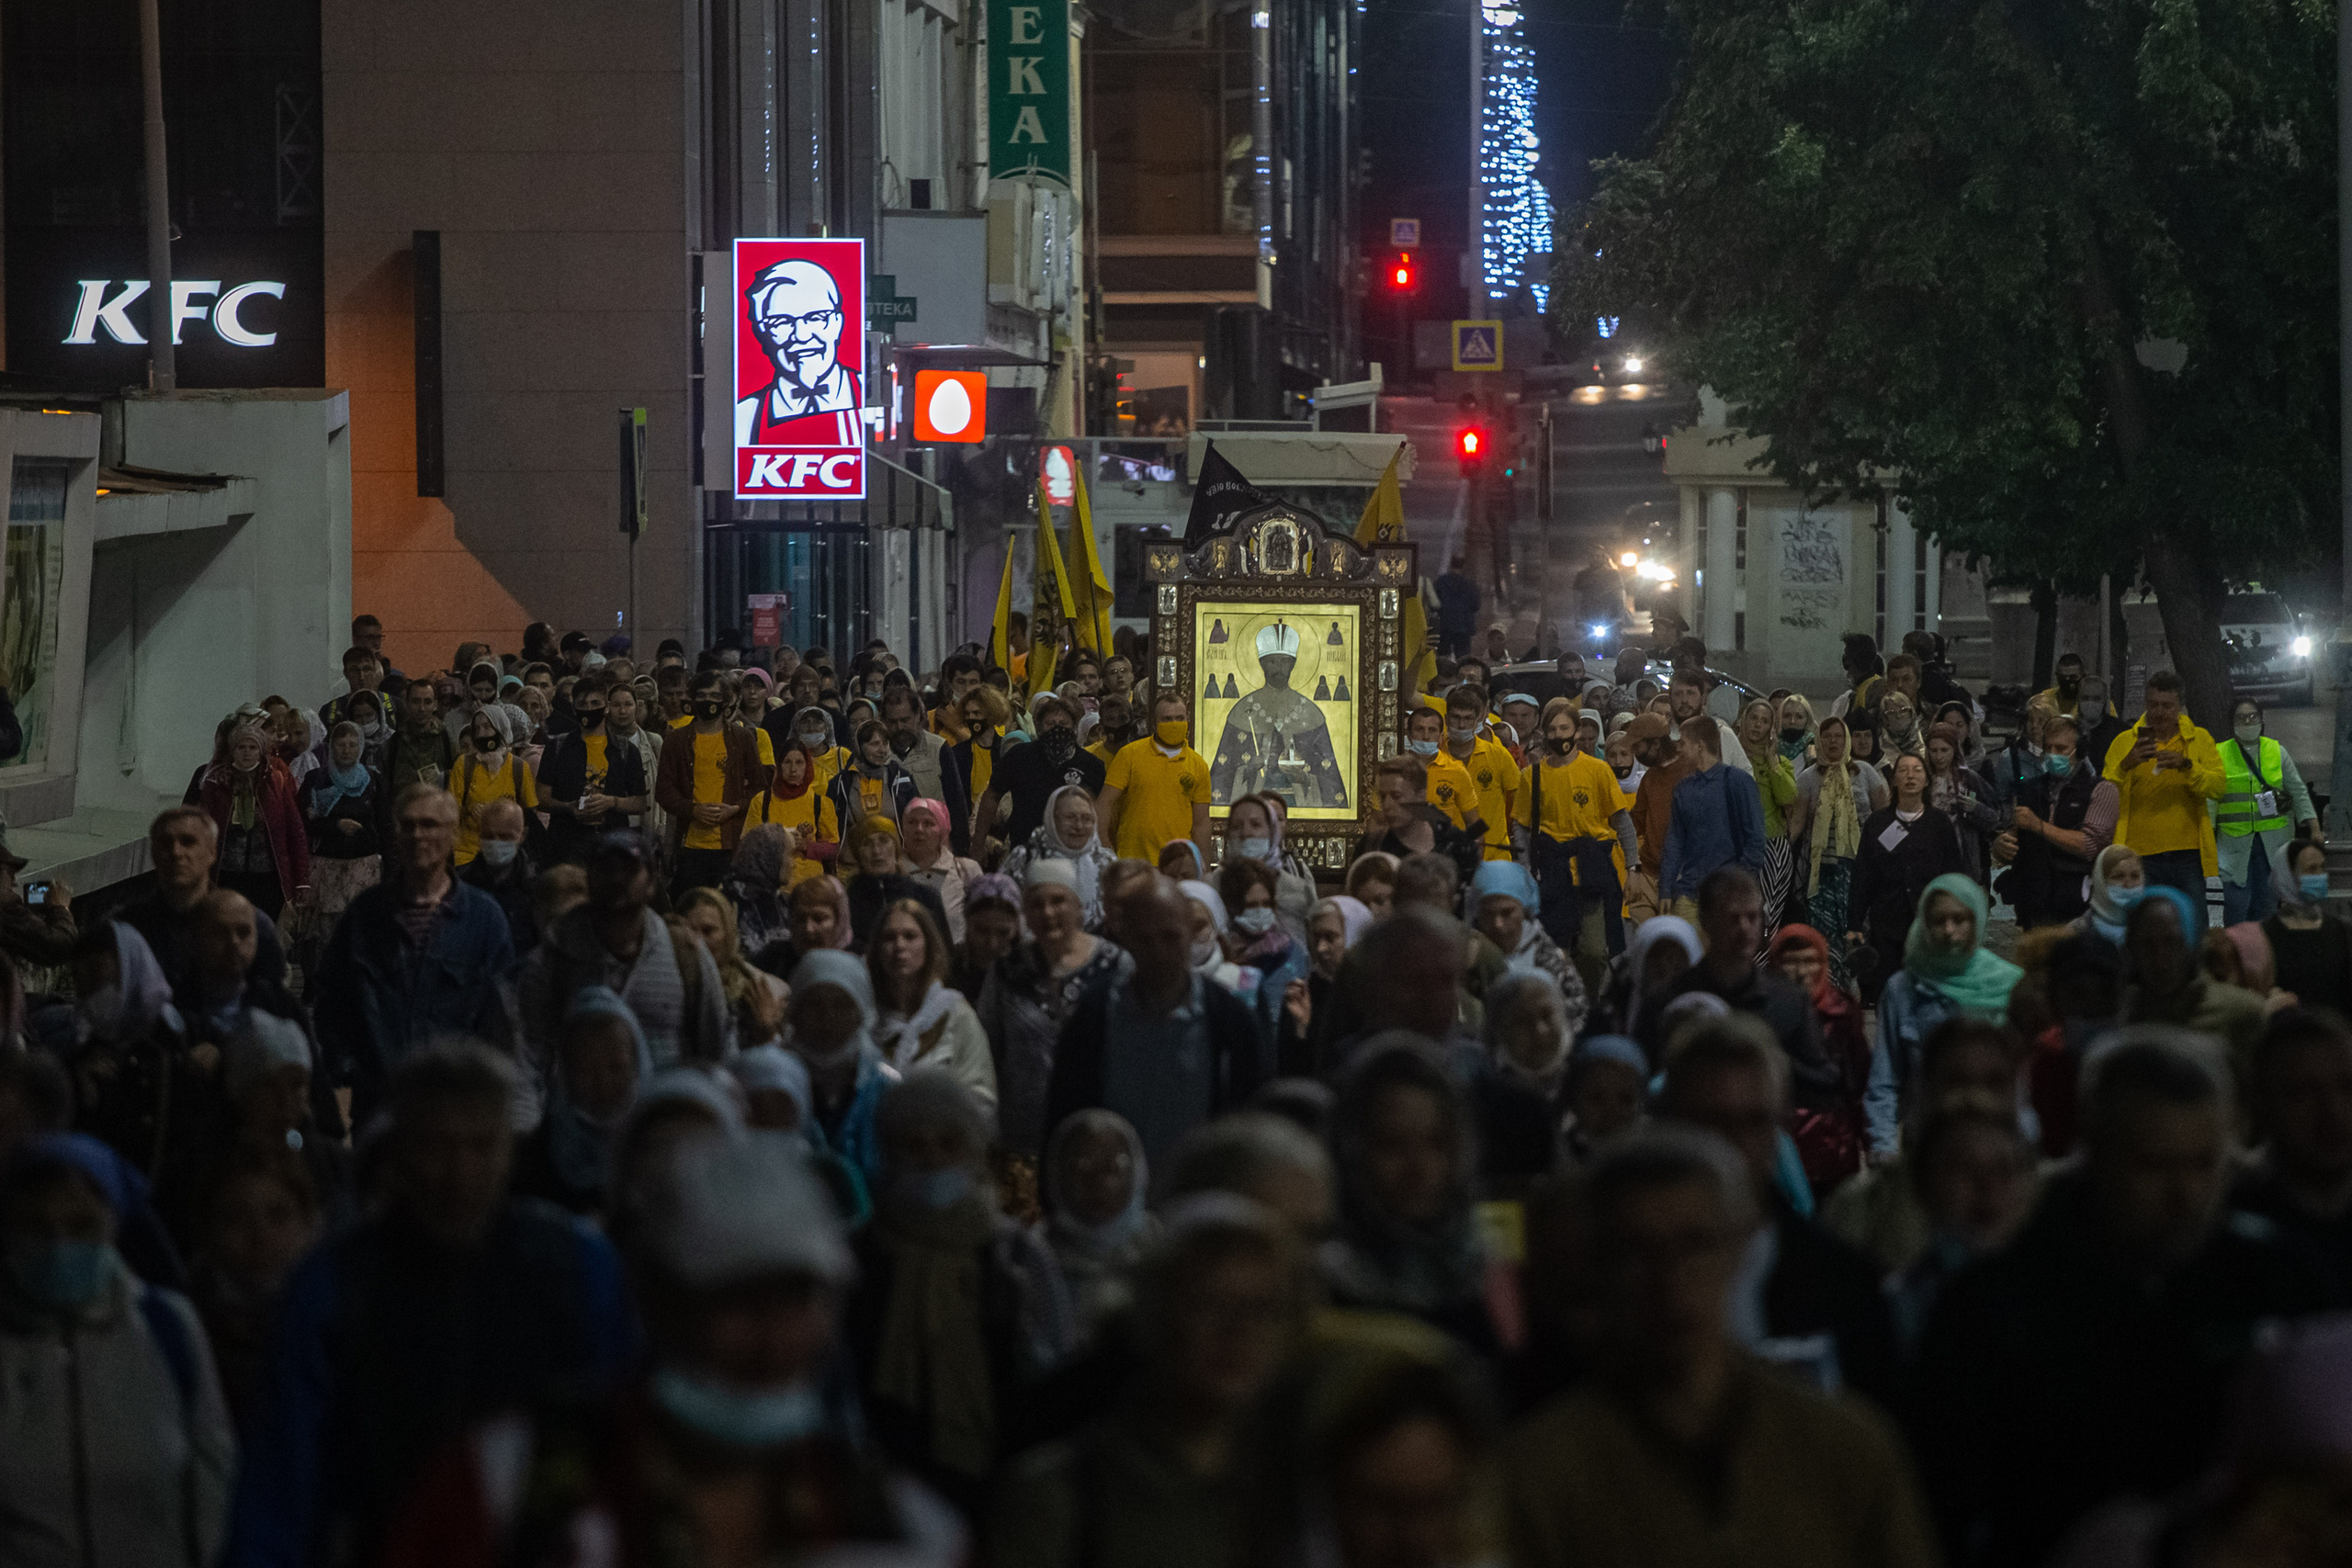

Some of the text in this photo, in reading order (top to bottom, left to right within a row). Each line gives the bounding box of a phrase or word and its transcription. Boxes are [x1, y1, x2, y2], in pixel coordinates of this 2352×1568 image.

[1008, 6, 1049, 144] ЕКА
[61, 279, 286, 346] KFC
[745, 454, 857, 489] KFC
